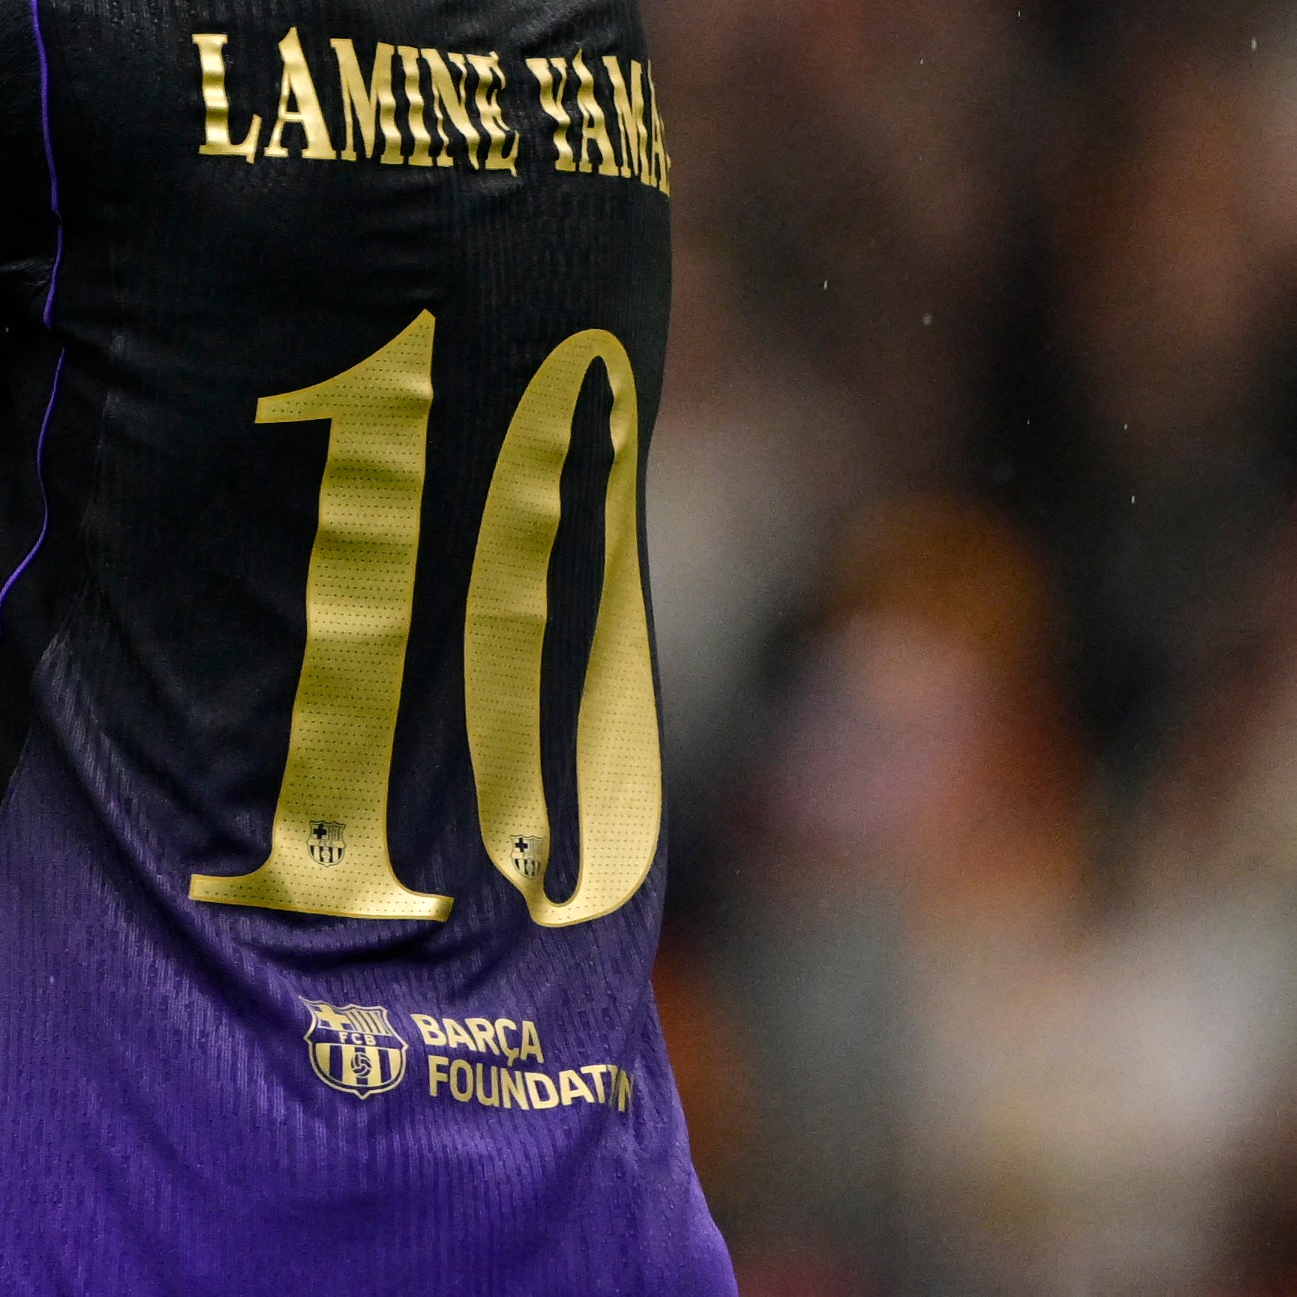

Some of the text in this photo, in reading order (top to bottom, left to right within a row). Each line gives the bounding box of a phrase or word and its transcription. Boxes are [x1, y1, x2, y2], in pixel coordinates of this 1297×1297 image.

[192, 27, 672, 195] LAMINE YAMA
[189, 309, 662, 927] 10
[339, 1032, 376, 1045] FCB
[410, 1013, 544, 1066] BARÇA
